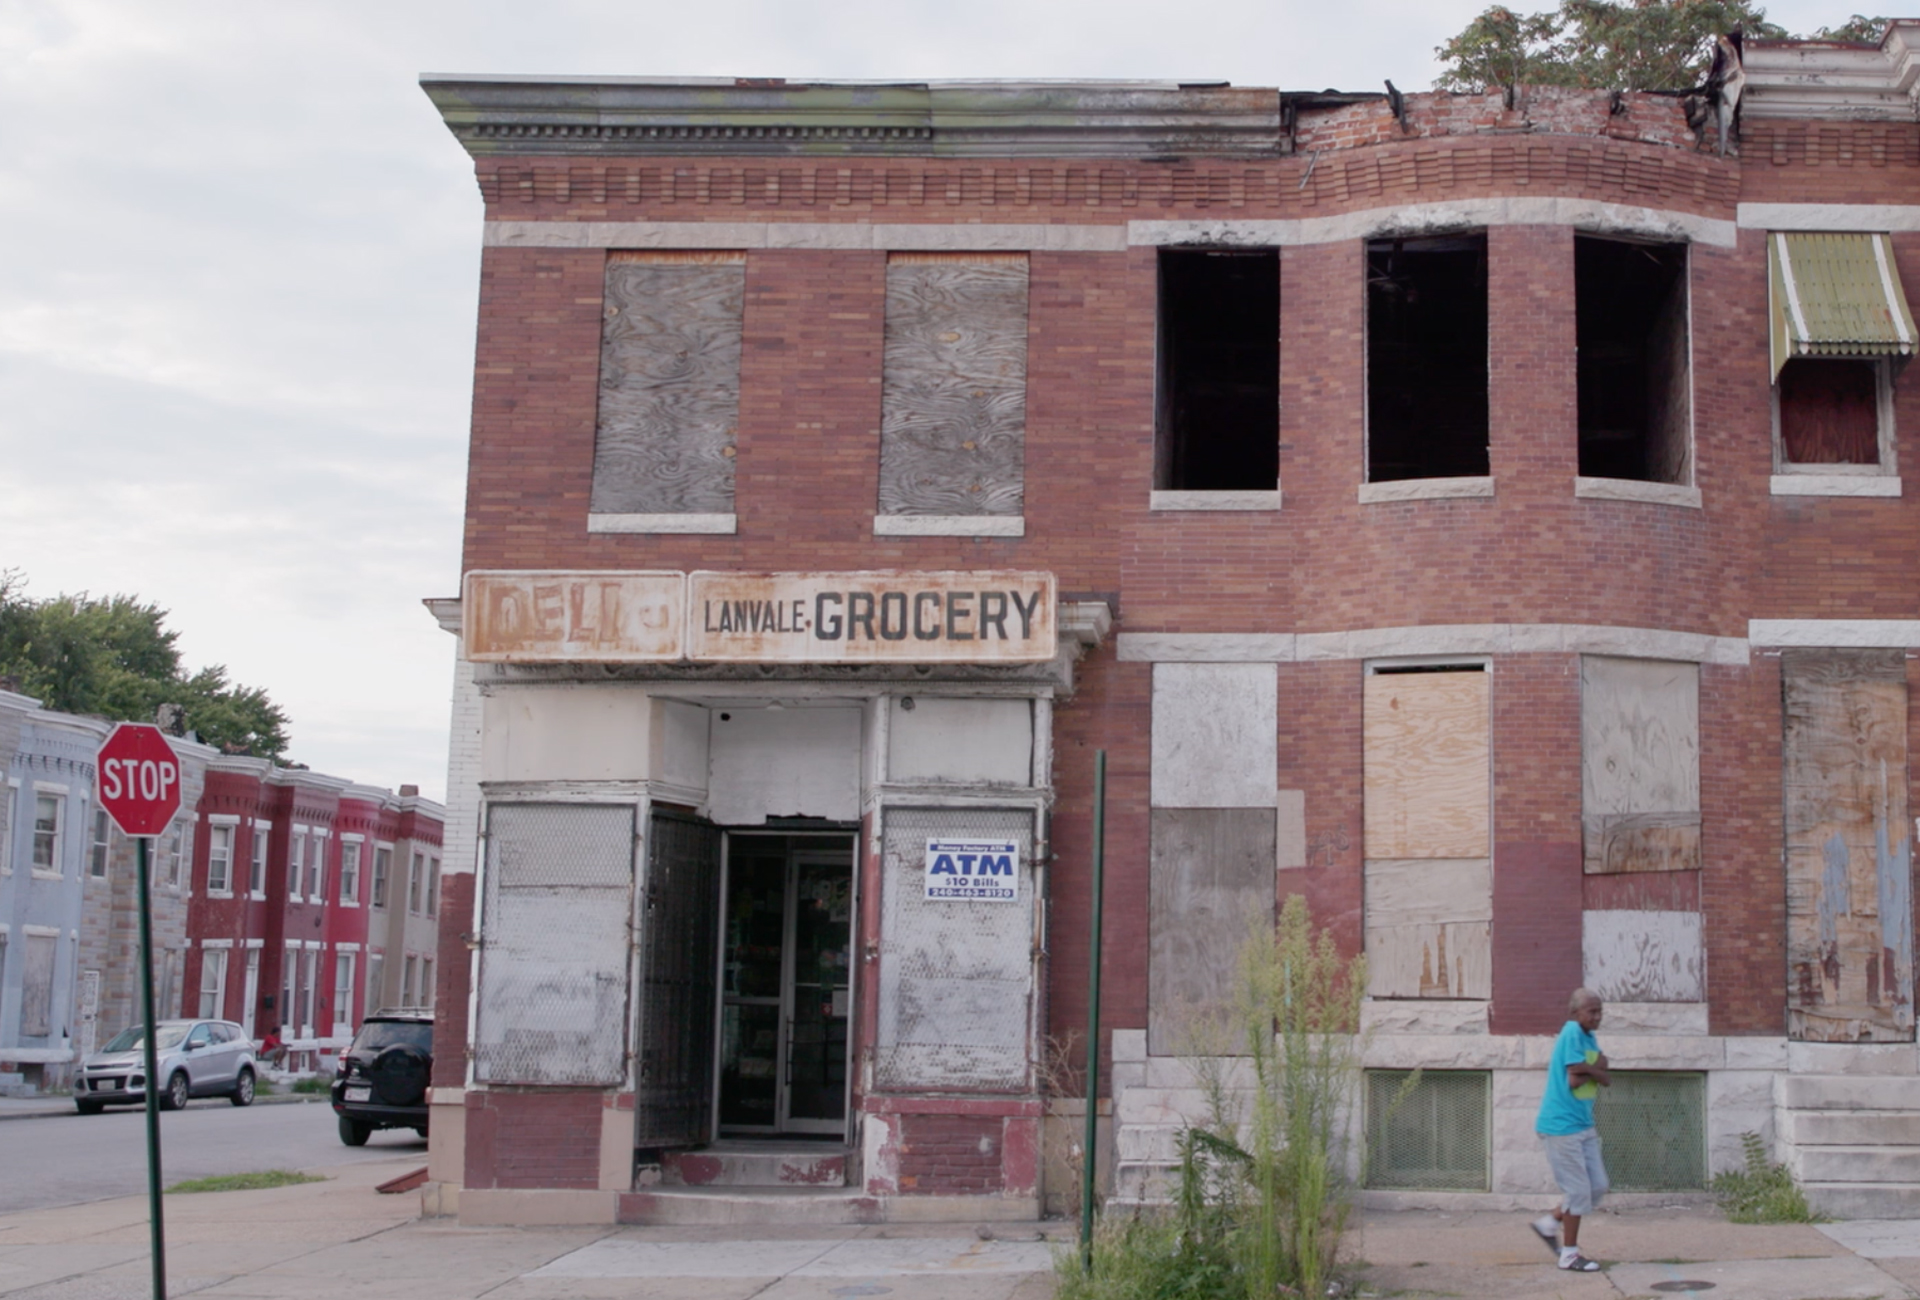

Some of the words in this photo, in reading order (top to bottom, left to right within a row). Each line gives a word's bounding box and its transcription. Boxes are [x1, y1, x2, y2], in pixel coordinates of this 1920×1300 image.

[704, 600, 806, 633] LANVALE
[815, 591, 1039, 641] GROCERY
[103, 758, 177, 801] STOP
[930, 854, 1013, 875] ATM
[945, 877, 969, 887] $10
[973, 878, 1000, 887] Bills
